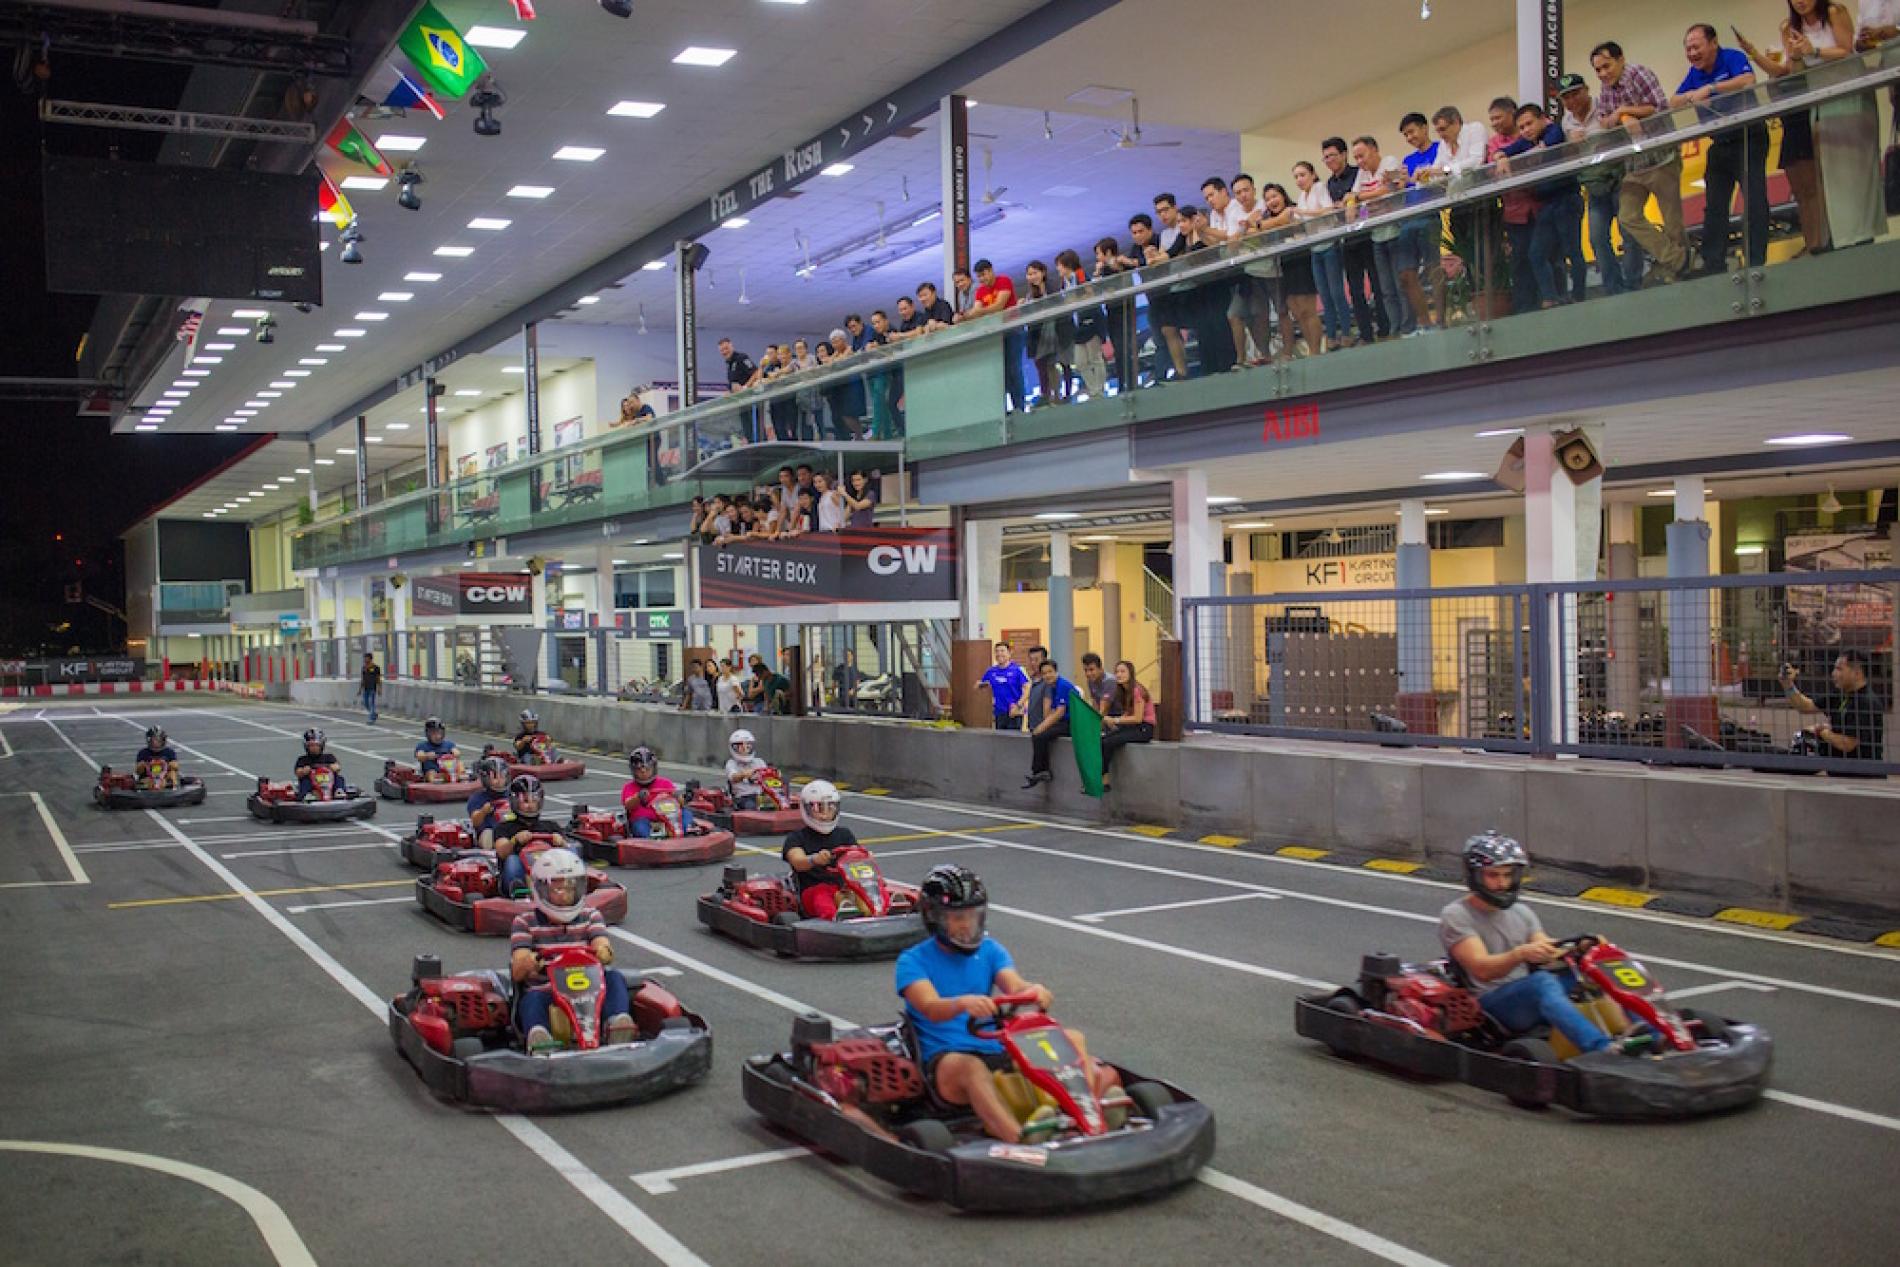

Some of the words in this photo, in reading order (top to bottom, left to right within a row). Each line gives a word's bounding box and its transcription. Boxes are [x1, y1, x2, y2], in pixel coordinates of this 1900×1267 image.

[1547, 0, 1558, 50] FACEB
[1548, 55, 1559, 78] ON
[710, 191, 739, 222] FEEL
[749, 168, 774, 200] THE
[784, 140, 822, 182] RUSH
[717, 552, 782, 580] STARTER
[785, 561, 817, 585] BOX
[867, 544, 938, 575] CW
[1306, 560, 1346, 586] KF1
[466, 586, 527, 603] CCW
[566, 971, 592, 991] 6
[1614, 968, 1646, 987] 8
[1035, 1038, 1060, 1062] 1
